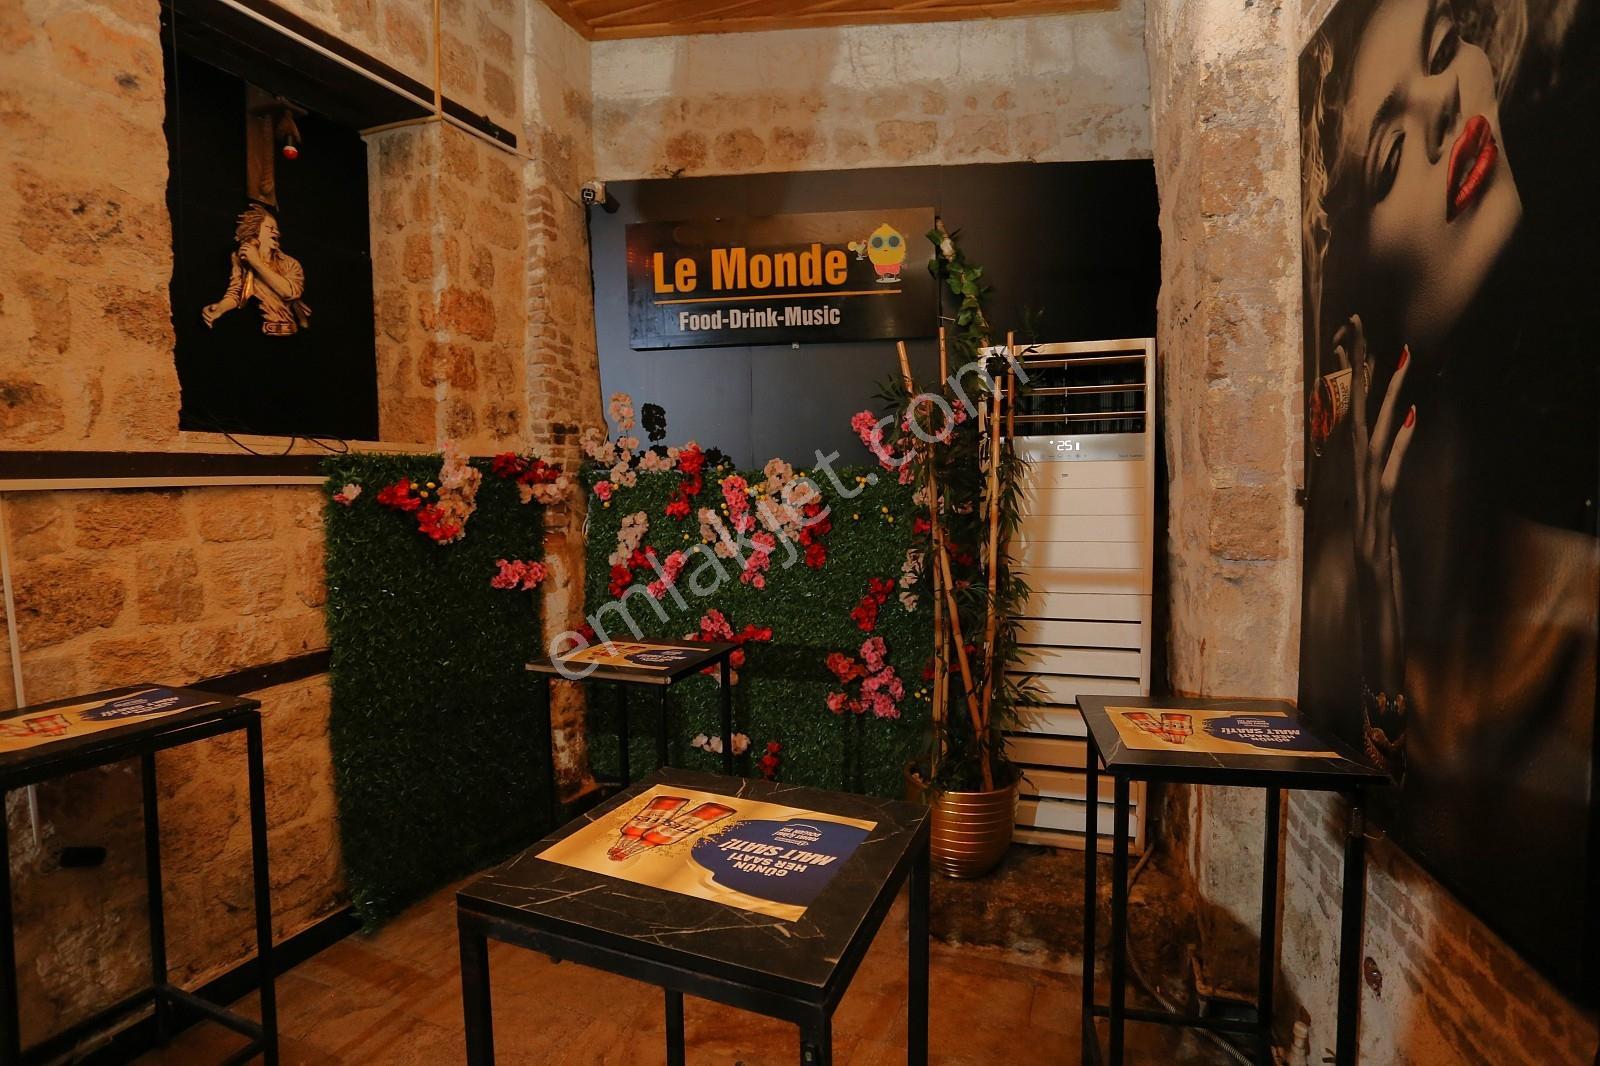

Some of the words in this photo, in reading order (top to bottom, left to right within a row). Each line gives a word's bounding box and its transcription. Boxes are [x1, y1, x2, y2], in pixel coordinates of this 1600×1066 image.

[653, 251, 697, 294] Le
[711, 243, 848, 290] Monde
[679, 305, 841, 331] Food-Drink-Music
[718, 838, 785, 856] SAATİ!
[726, 852, 775, 865] SAATİ
[774, 859, 808, 873] HER
[780, 849, 838, 866] MALT
[732, 861, 789, 877] GÜNÜN
